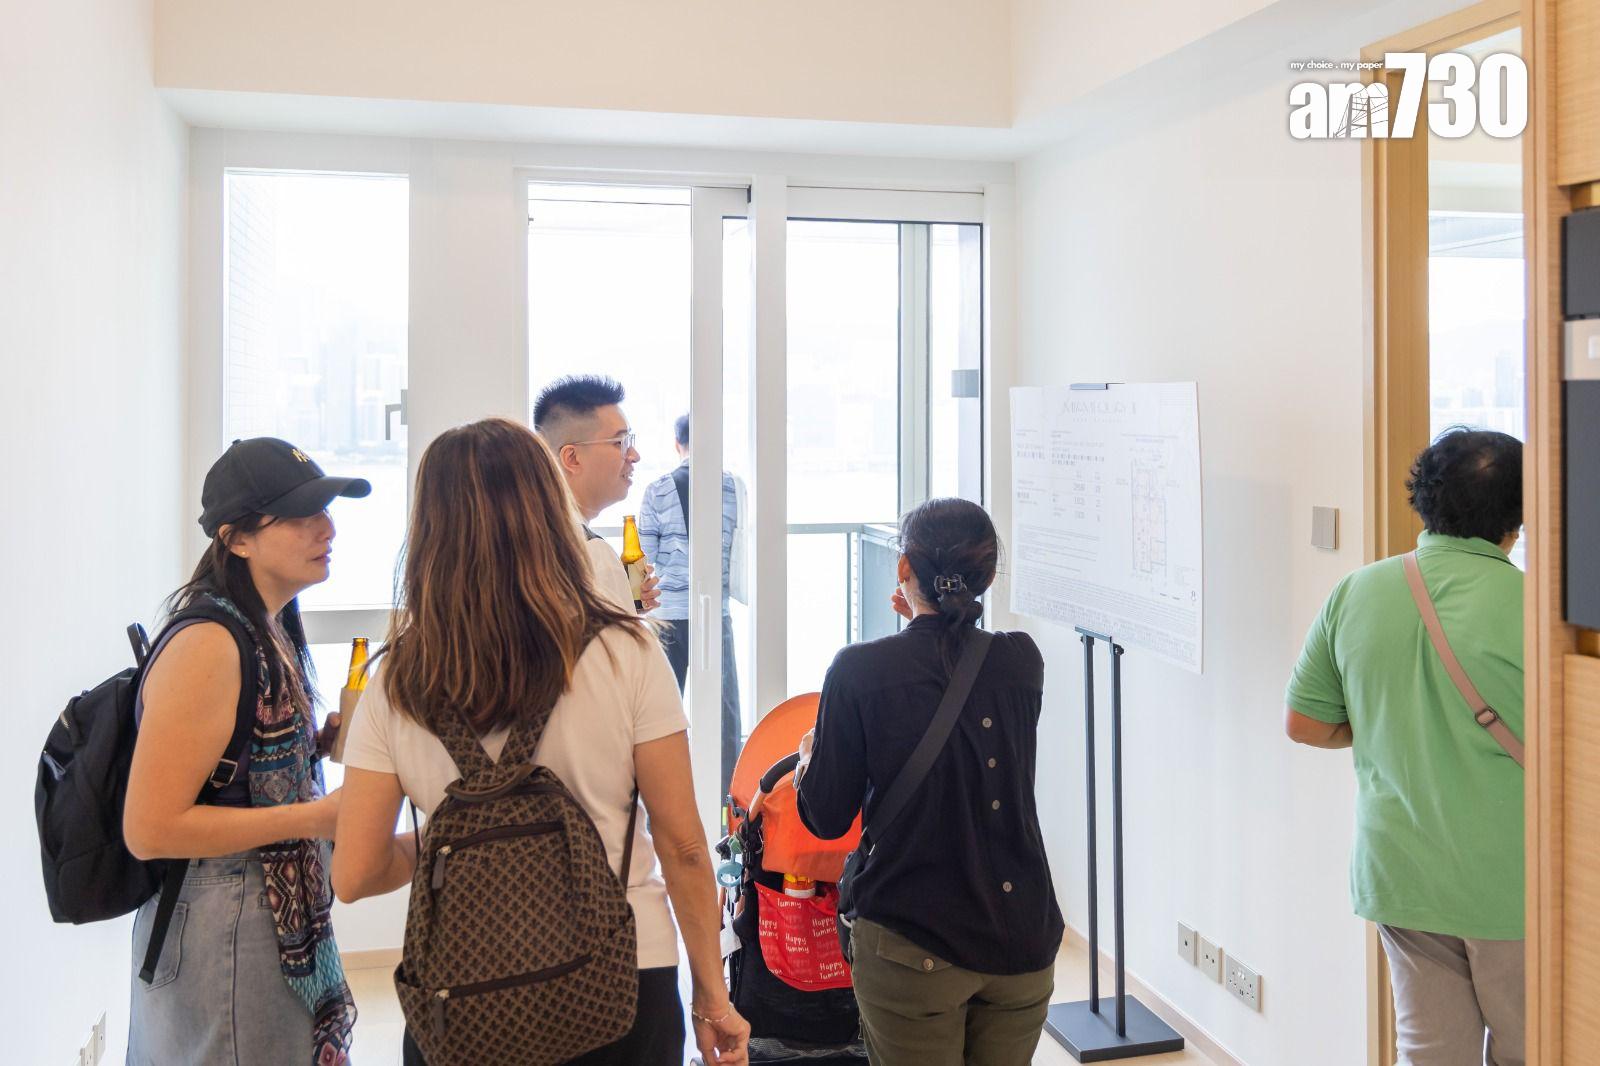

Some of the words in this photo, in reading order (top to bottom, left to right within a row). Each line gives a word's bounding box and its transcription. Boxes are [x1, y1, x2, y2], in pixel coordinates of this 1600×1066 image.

[812, 916, 834, 927] Happy
[759, 930, 779, 940] ummy
[785, 933, 807, 945] Happy
[819, 961, 843, 971] Happy
